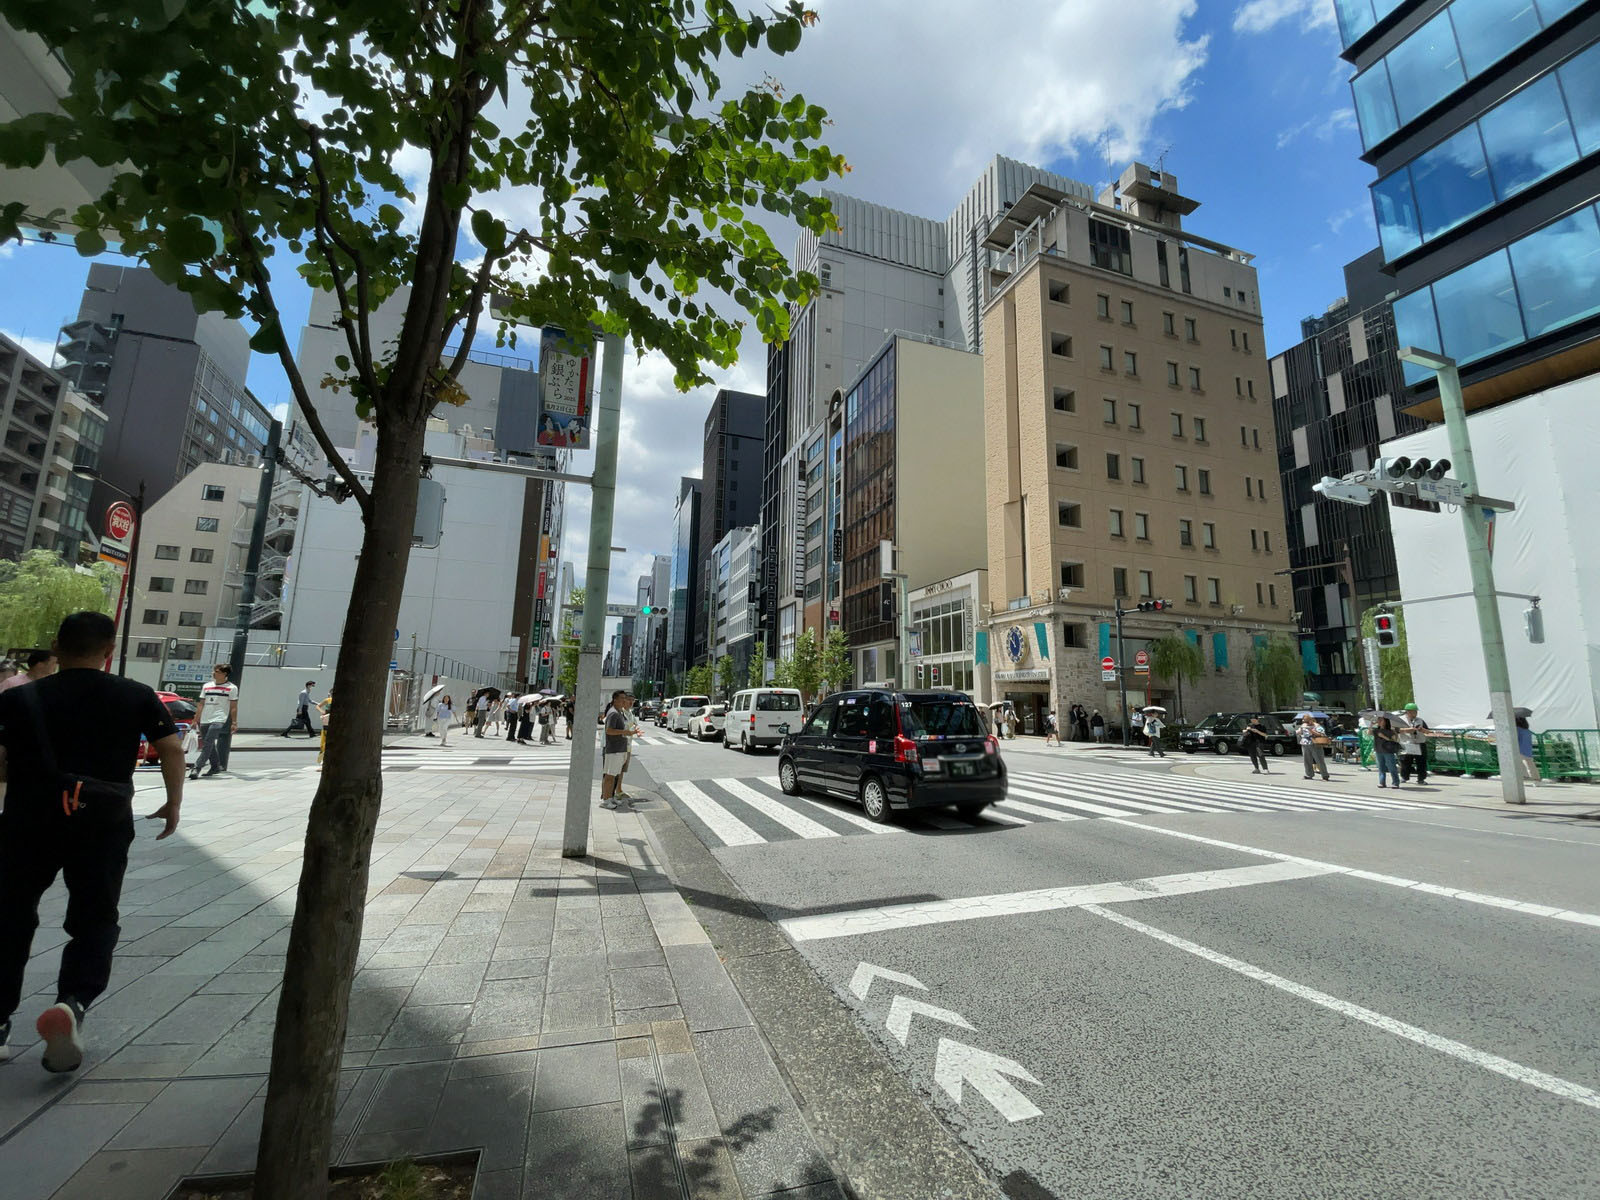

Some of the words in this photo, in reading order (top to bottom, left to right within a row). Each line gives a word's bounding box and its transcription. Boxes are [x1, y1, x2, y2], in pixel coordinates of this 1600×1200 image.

[548, 362, 564, 400] 銀ぶら
[564, 359, 579, 394] ゆかたで
